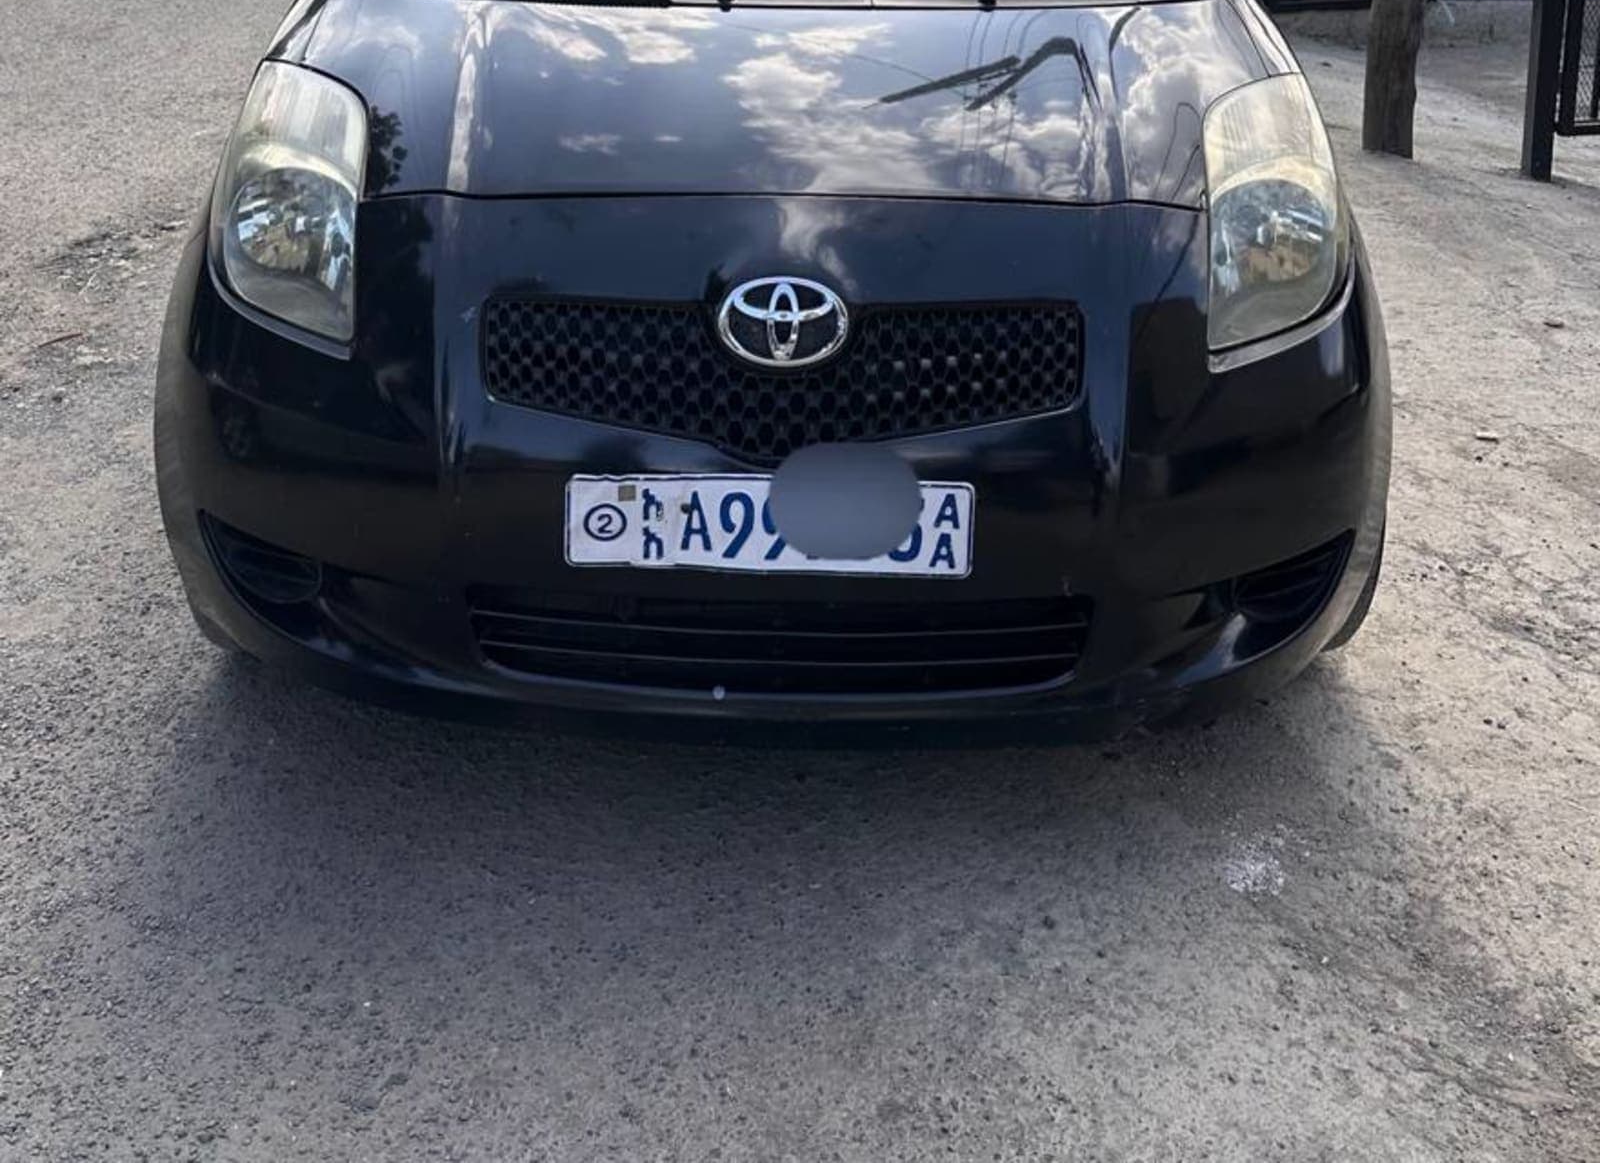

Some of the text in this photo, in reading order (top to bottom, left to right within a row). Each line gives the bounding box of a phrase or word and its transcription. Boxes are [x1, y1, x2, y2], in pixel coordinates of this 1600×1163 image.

[597, 513, 613, 534] 2
[934, 493, 960, 530] A
[929, 533, 956, 570] A
